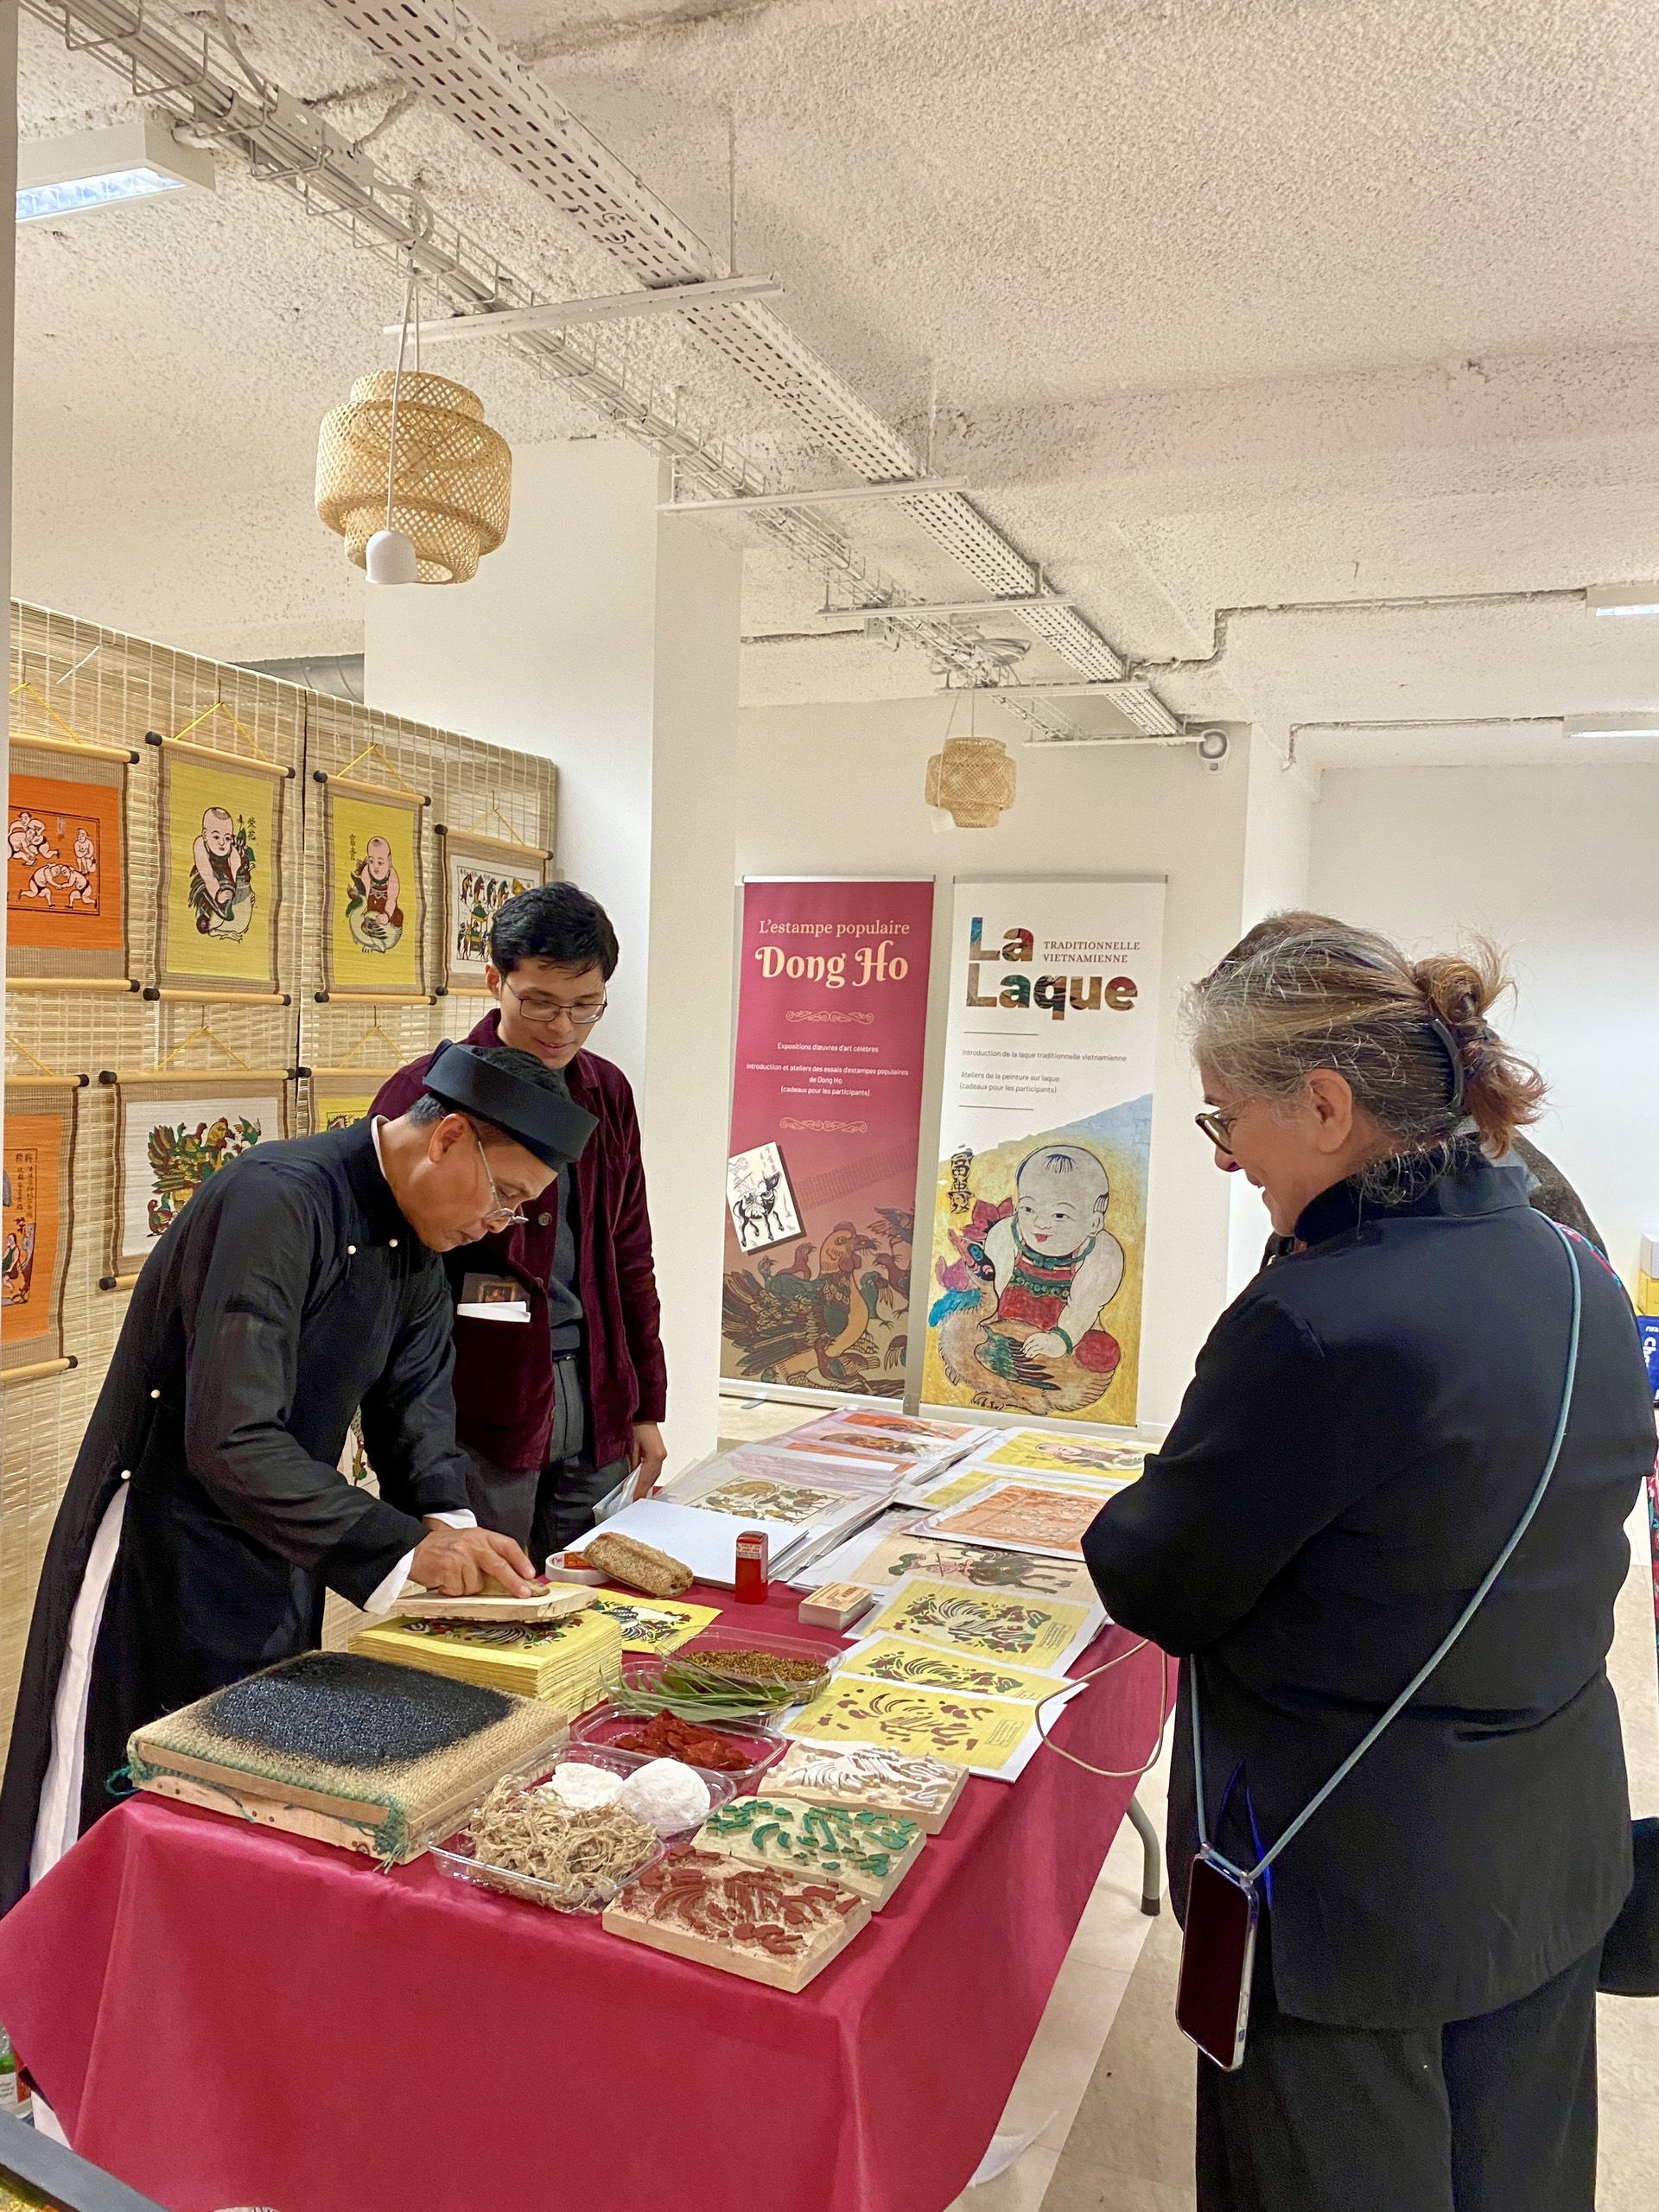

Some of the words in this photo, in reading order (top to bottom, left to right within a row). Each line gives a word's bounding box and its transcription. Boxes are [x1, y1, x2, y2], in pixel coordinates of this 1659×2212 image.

[760, 919, 833, 938] L'estampe
[836, 919, 910, 938] populaire
[969, 917, 1034, 962] La
[1043, 940, 1141, 950] TRADITIONNELLE
[1043, 953, 1128, 963] VIETNAMIENNE
[754, 946, 846, 988] Dong
[852, 940, 908, 987] Ho
[966, 963, 1138, 1020] Laque
[777, 1042, 811, 1052] Expositions
[963, 1049, 1001, 1058] Introduction
[877, 1068, 909, 1077] populaires
[1001, 1073, 1029, 1082] peinture
[817, 1077, 833, 1085] Dong
[781, 1085, 807, 1094] (cadeaux
[831, 1089, 870, 1097] participants)
[959, 1082, 988, 1090] (cadeaux
[1015, 1085, 1057, 1094] participants)
